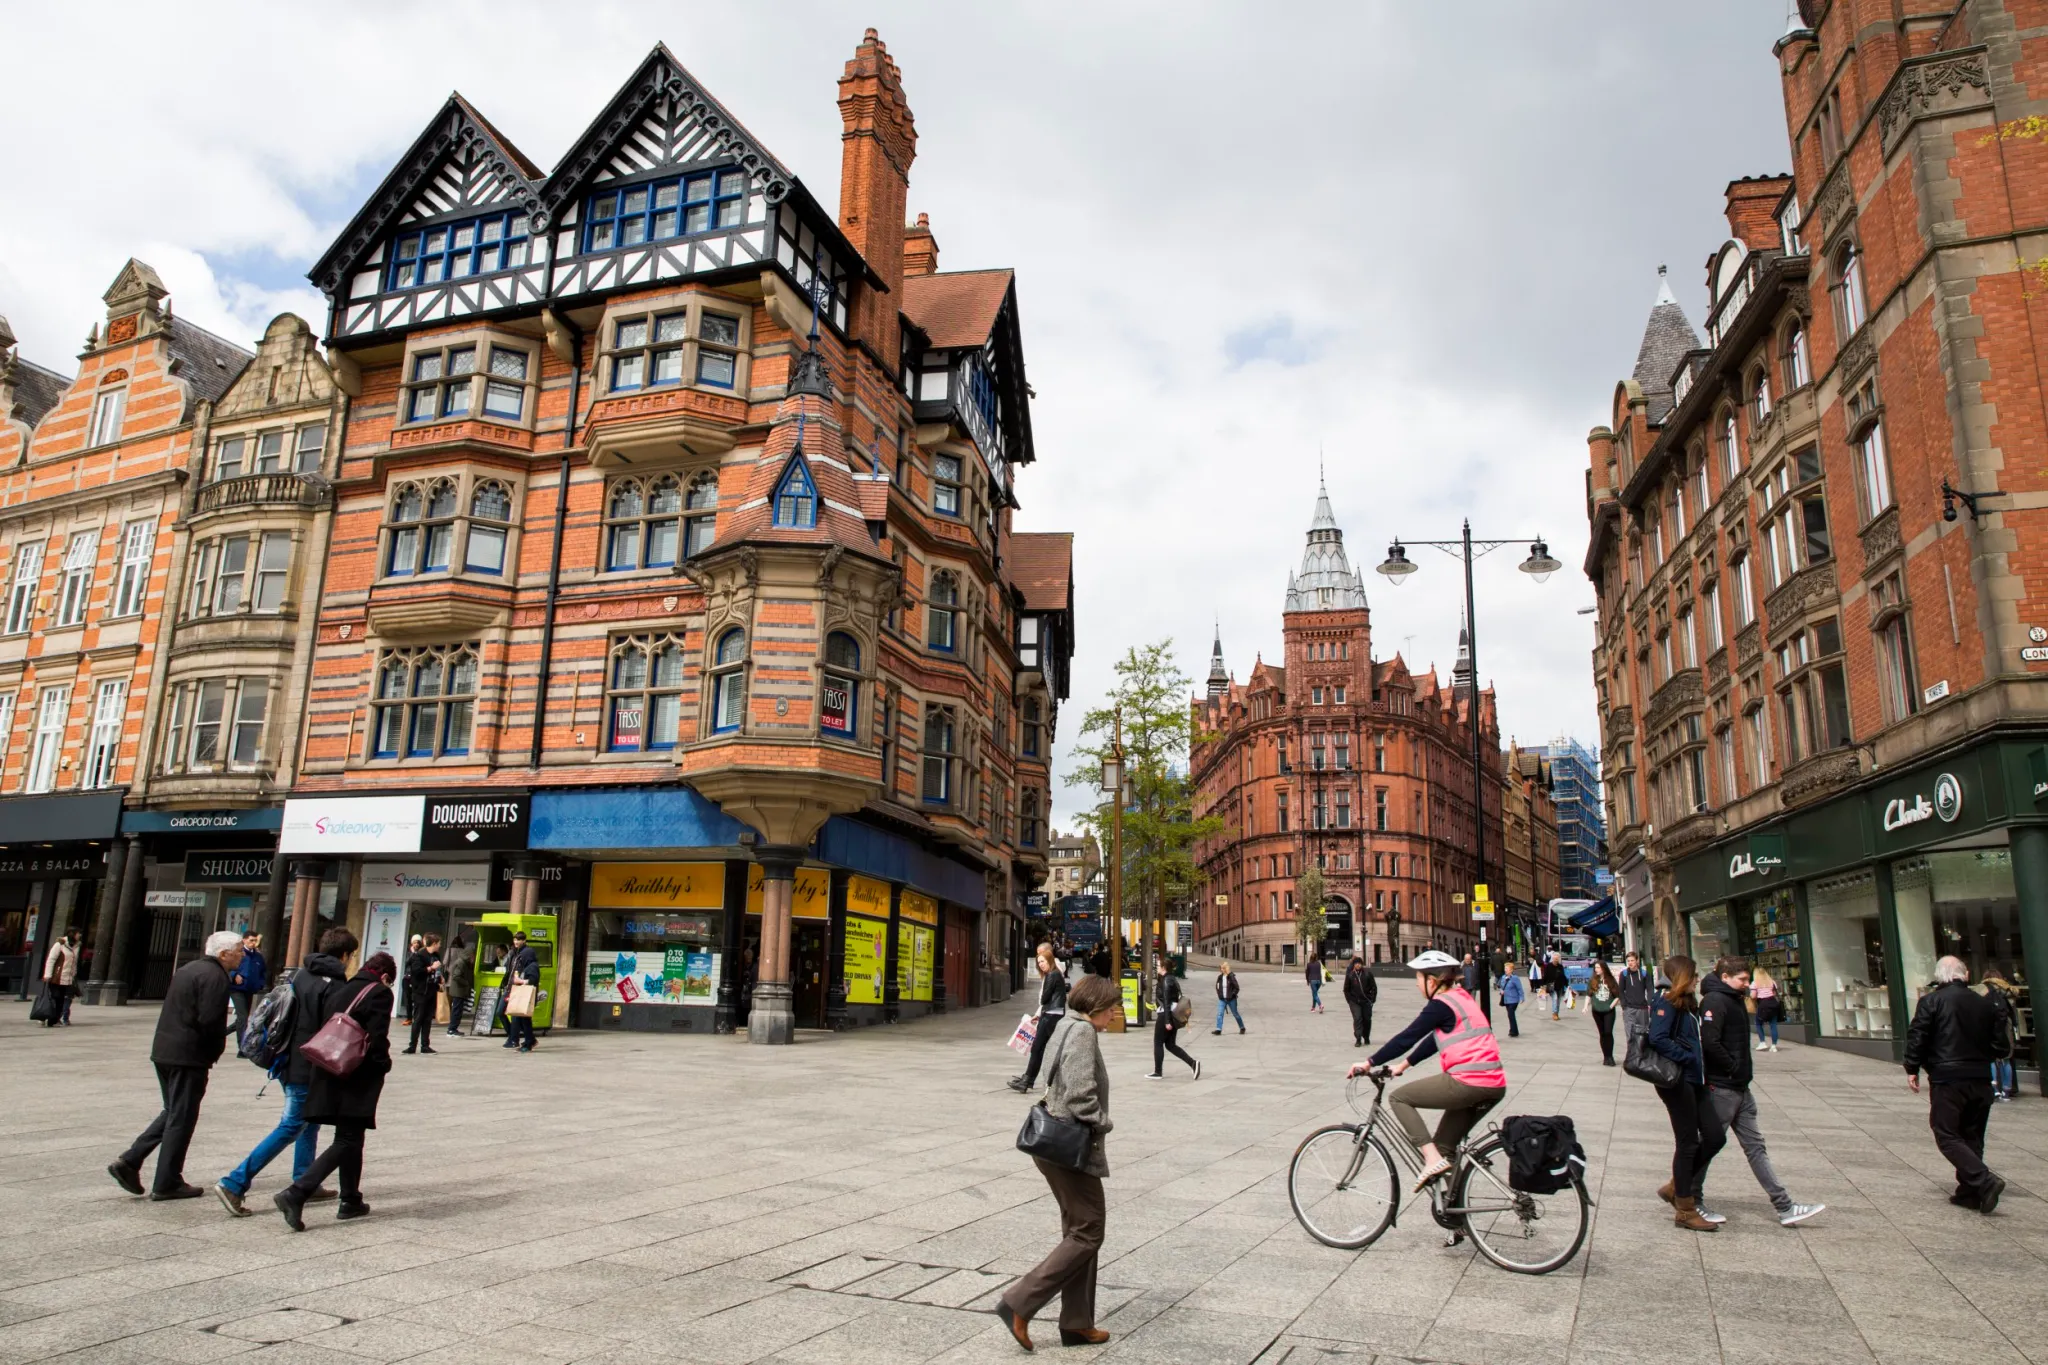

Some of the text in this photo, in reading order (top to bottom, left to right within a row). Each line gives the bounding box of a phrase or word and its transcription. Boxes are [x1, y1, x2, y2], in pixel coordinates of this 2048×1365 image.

[822, 715, 844, 727] TO LET
[628, 735, 641, 743] LET
[432, 803, 518, 824] DOUGHNOTTS
[1884, 795, 1933, 832] Clarks
[170, 816, 238, 827] CHIROPODY CLINIC
[315, 816, 386, 839] Shakeaway
[31, 861, 38, 871] &
[46, 859, 91, 871] SALAD
[1755, 856, 1782, 865] Clarks
[394, 872, 454, 892] Shakeaway
[619, 876, 691, 900] Raithby's
[845, 920, 857, 928] obs
[845, 928, 873, 939] andwiches
